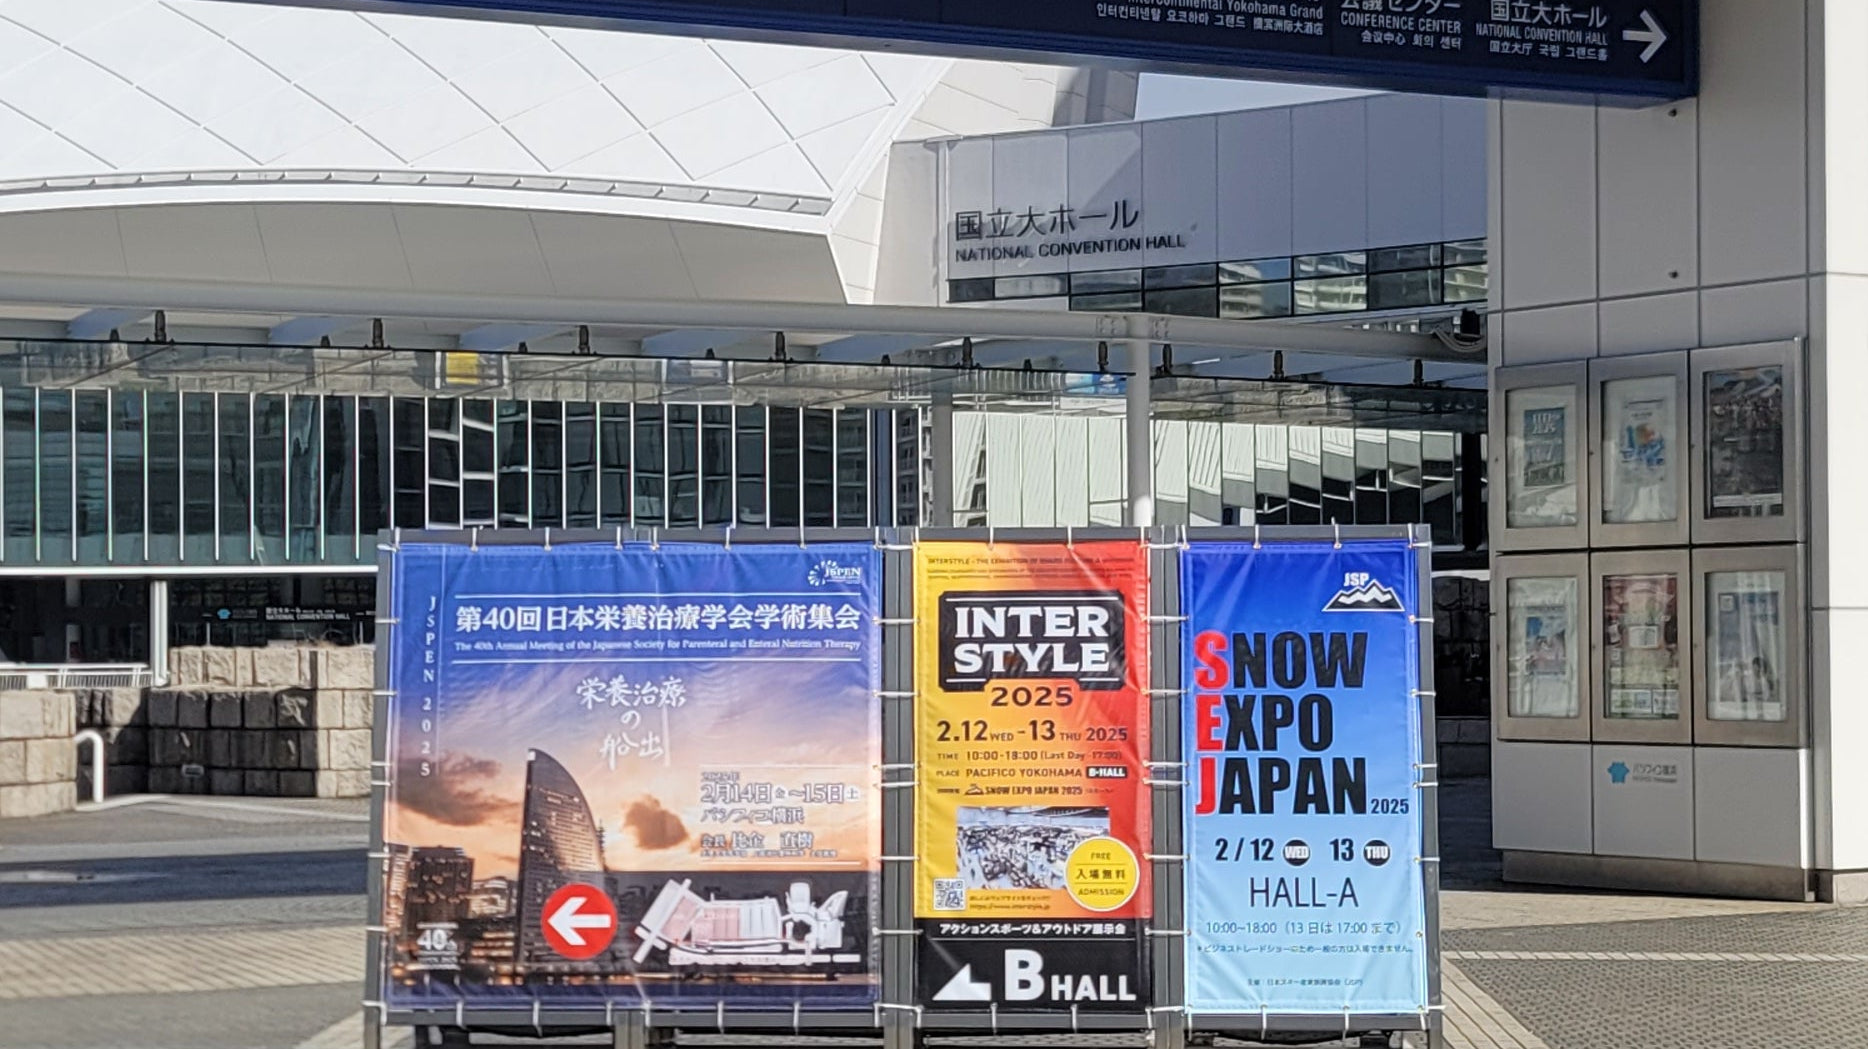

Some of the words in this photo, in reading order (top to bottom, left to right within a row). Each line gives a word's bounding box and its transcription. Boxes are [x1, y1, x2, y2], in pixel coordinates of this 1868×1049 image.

[1166, 8, 1210, 25] 요코하마
[1213, 13, 1246, 28] 그랜드
[1227, 0, 1286, 16] Yokohama
[1289, 3, 1323, 20] Grand
[1490, 0, 1608, 28] 国立大ホール
[1340, 11, 1415, 30] CONFERENCE
[1418, 17, 1461, 33] CENTER
[1475, 23, 1522, 39] NATIONAL
[1524, 26, 1582, 43] CONVENTION
[1585, 31, 1608, 45] HALL
[955, 200, 1139, 240] 国立大ホール
[955, 245, 1034, 262] NATIONAL
[1038, 237, 1142, 257] CONVENTION
[1145, 234, 1186, 249] HALL
[1344, 572, 1369, 587] JSP
[954, 606, 1110, 638] INTER
[423, 595, 437, 683] JSPEN
[455, 641, 472, 650] The
[474, 641, 493, 650] 40th
[495, 641, 527, 650] Annual
[529, 641, 564, 651] Meeting
[566, 640, 575, 649] of
[577, 640, 591, 649] the
[593, 640, 632, 651] Japanese
[634, 640, 664, 650] Society
[667, 639, 680, 649] for
[682, 639, 727, 648] Parenteral
[729, 639, 746, 648] and
[748, 639, 780, 648] Enteral
[782, 639, 821, 648] Nutrition
[824, 639, 861, 650] Therapy
[953, 643, 1110, 673] STYLE
[1194, 630, 1368, 690] SNOW
[576, 674, 687, 710] 栄養治療
[991, 687, 1073, 706] 2025
[621, 710, 641, 730] の
[937, 720, 988, 741] 2.12
[990, 733, 1014, 742] WED
[1060, 733, 1081, 741] THU
[1086, 728, 1128, 741] 2025
[1196, 693, 1333, 752] EXPO
[420, 697, 432, 776] 2025
[600, 731, 664, 771] 船出
[967, 751, 1038, 761] 10:00-18:00
[1040, 751, 1065, 761] (Last
[1067, 751, 1085, 761] Day
[966, 768, 1015, 778] PACIFICO
[1019, 768, 1082, 777] YOKOHAMA
[985, 786, 1010, 795] SNOW
[1012, 786, 1032, 795] EXPO
[1034, 786, 1060, 795] JAPAN
[1061, 786, 1083, 795] 2025
[1195, 757, 1367, 815] JAPAN
[1371, 798, 1409, 815] 2025
[700, 806, 805, 823] パシフィコ横浜
[702, 834, 727, 848] 会長
[1285, 846, 1309, 859] WED
[1330, 838, 1354, 861] 13
[1365, 846, 1388, 858] THU
[1091, 852, 1111, 860] FREE
[1076, 868, 1125, 880] 入場無料
[1250, 877, 1359, 907] HALL-A
[1005, 949, 1045, 1000] B
[1051, 975, 1136, 1000] HALL
